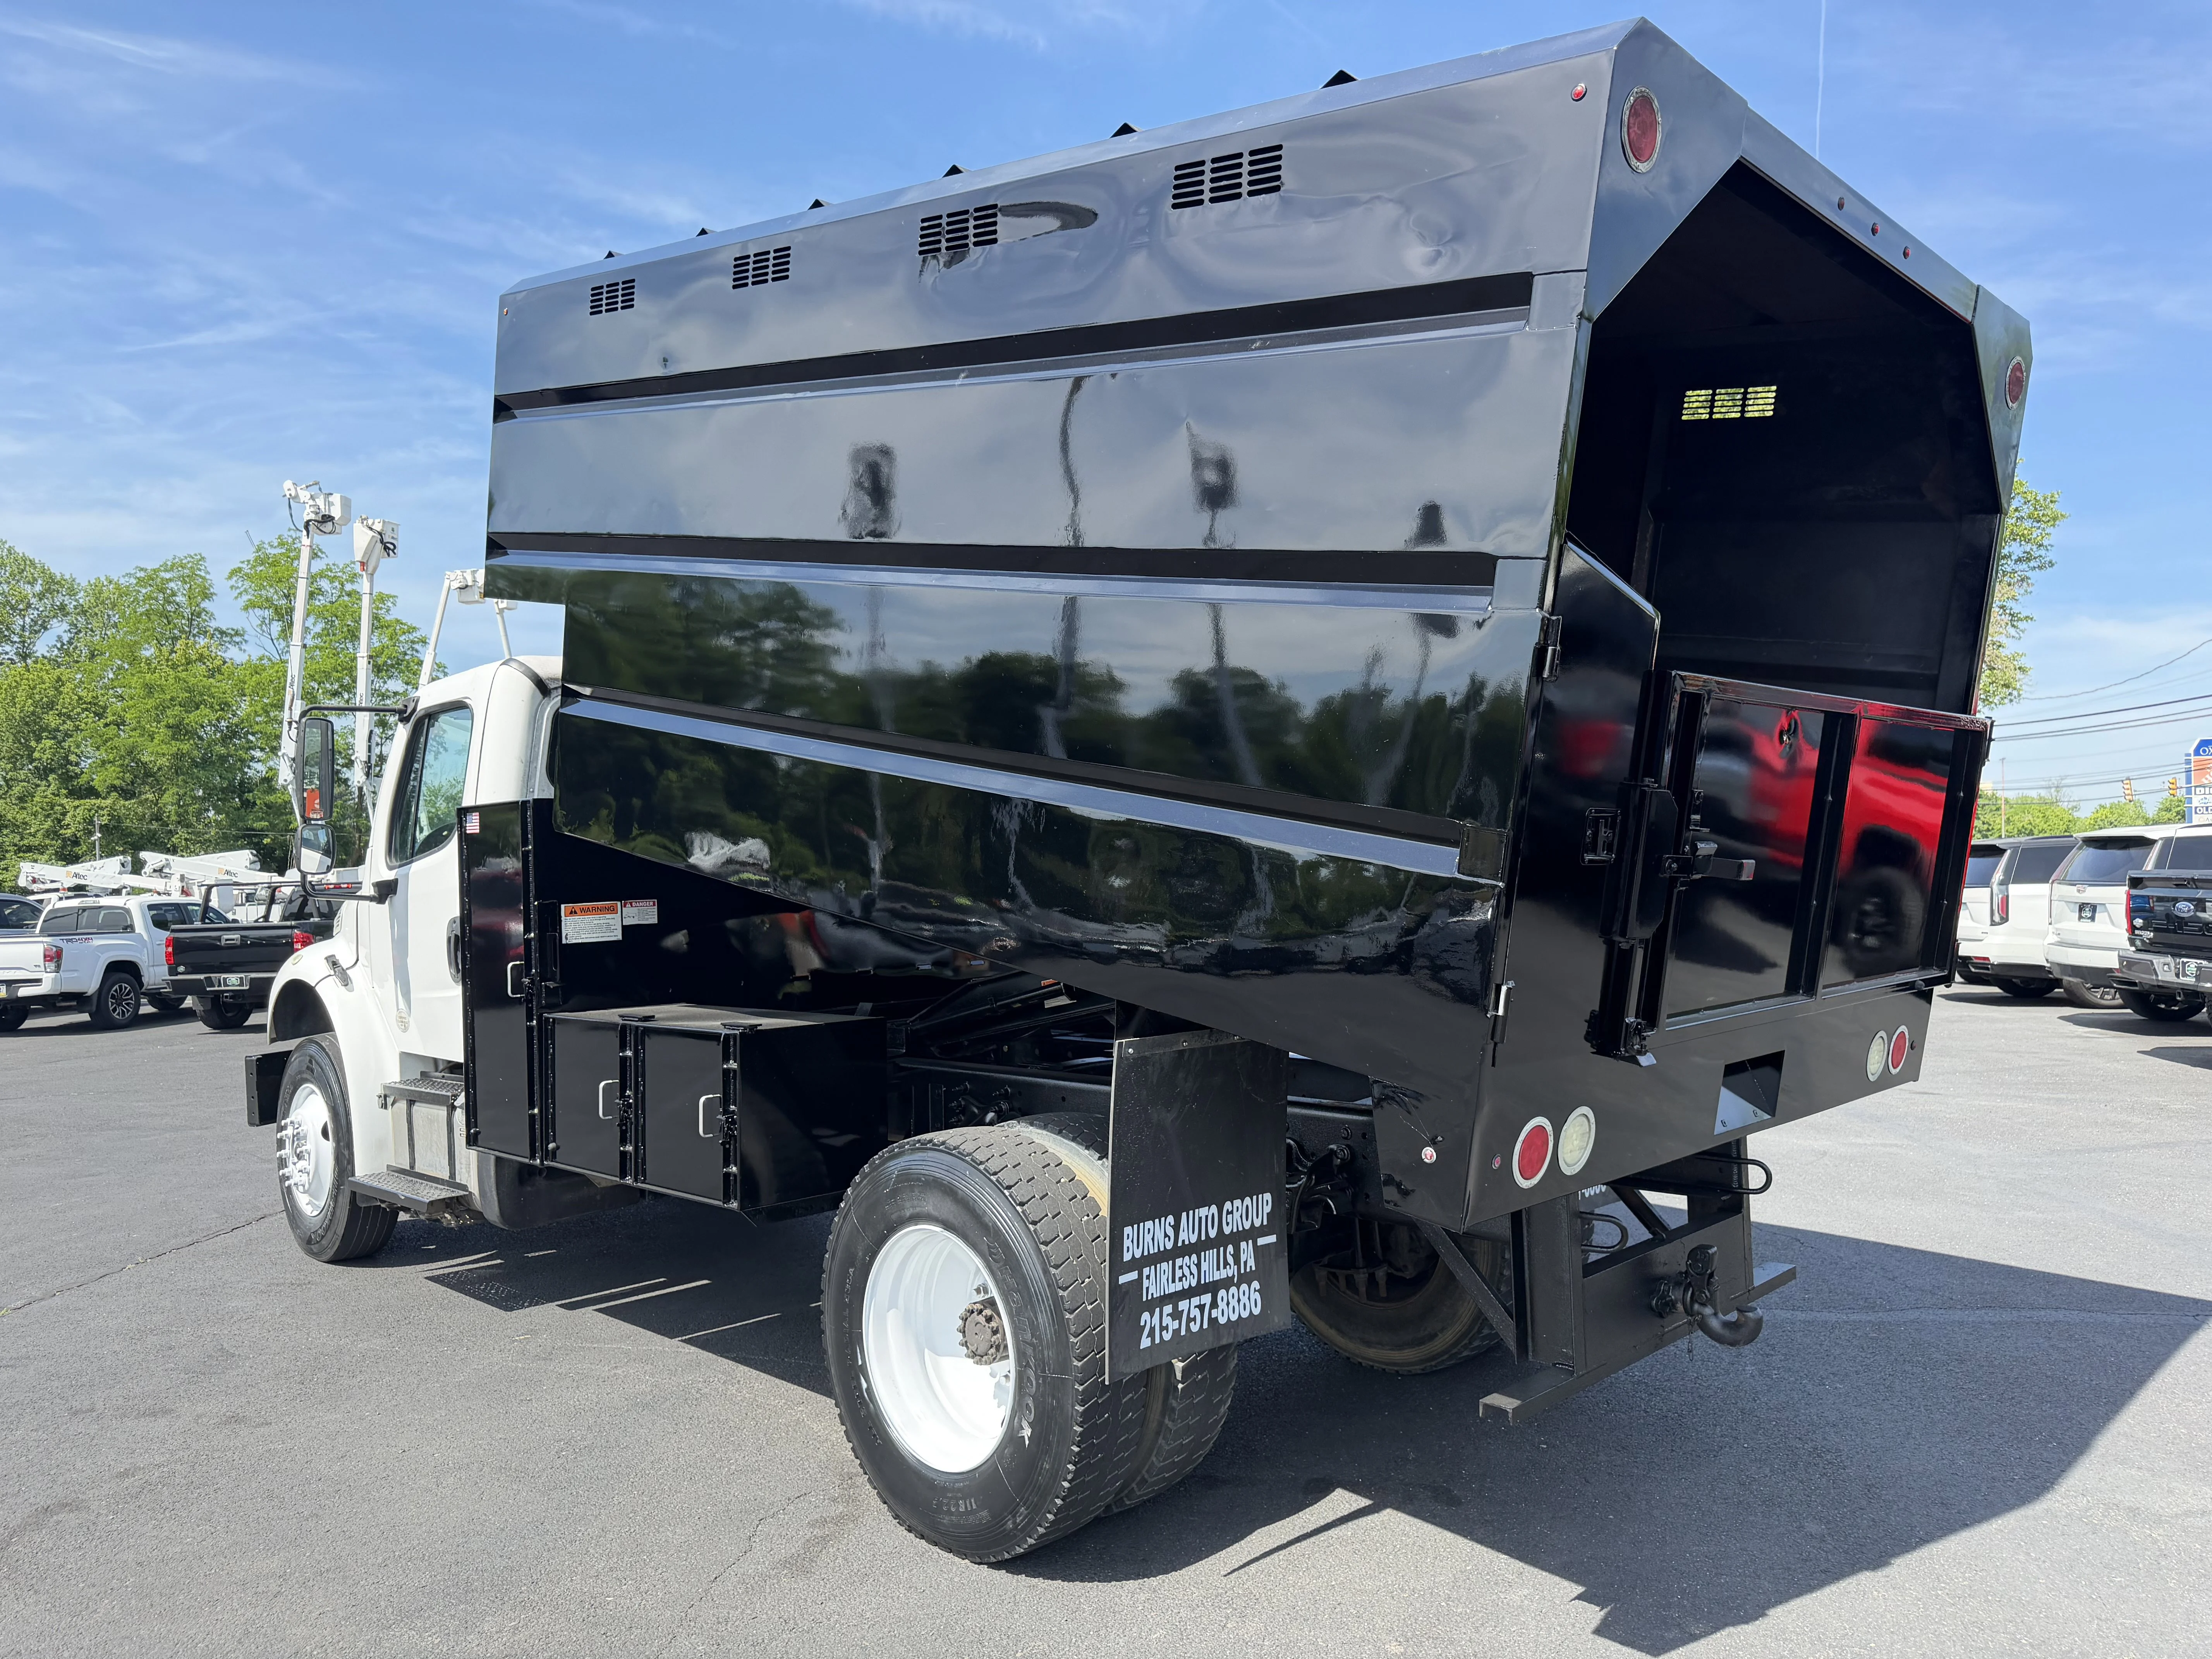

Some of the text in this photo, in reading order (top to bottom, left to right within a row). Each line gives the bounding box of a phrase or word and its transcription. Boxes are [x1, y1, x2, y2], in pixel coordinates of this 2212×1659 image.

[72, 872, 88, 880] Altec
[223, 869, 238, 878] Altec
[579, 905, 615, 914] WARNING
[1123, 1192, 1272, 1262] BURNS AUTO GROUP
[1142, 1239, 1255, 1301] FAIRLESS HILLS, PA
[1140, 1280, 1261, 1349] 215-757-8886
